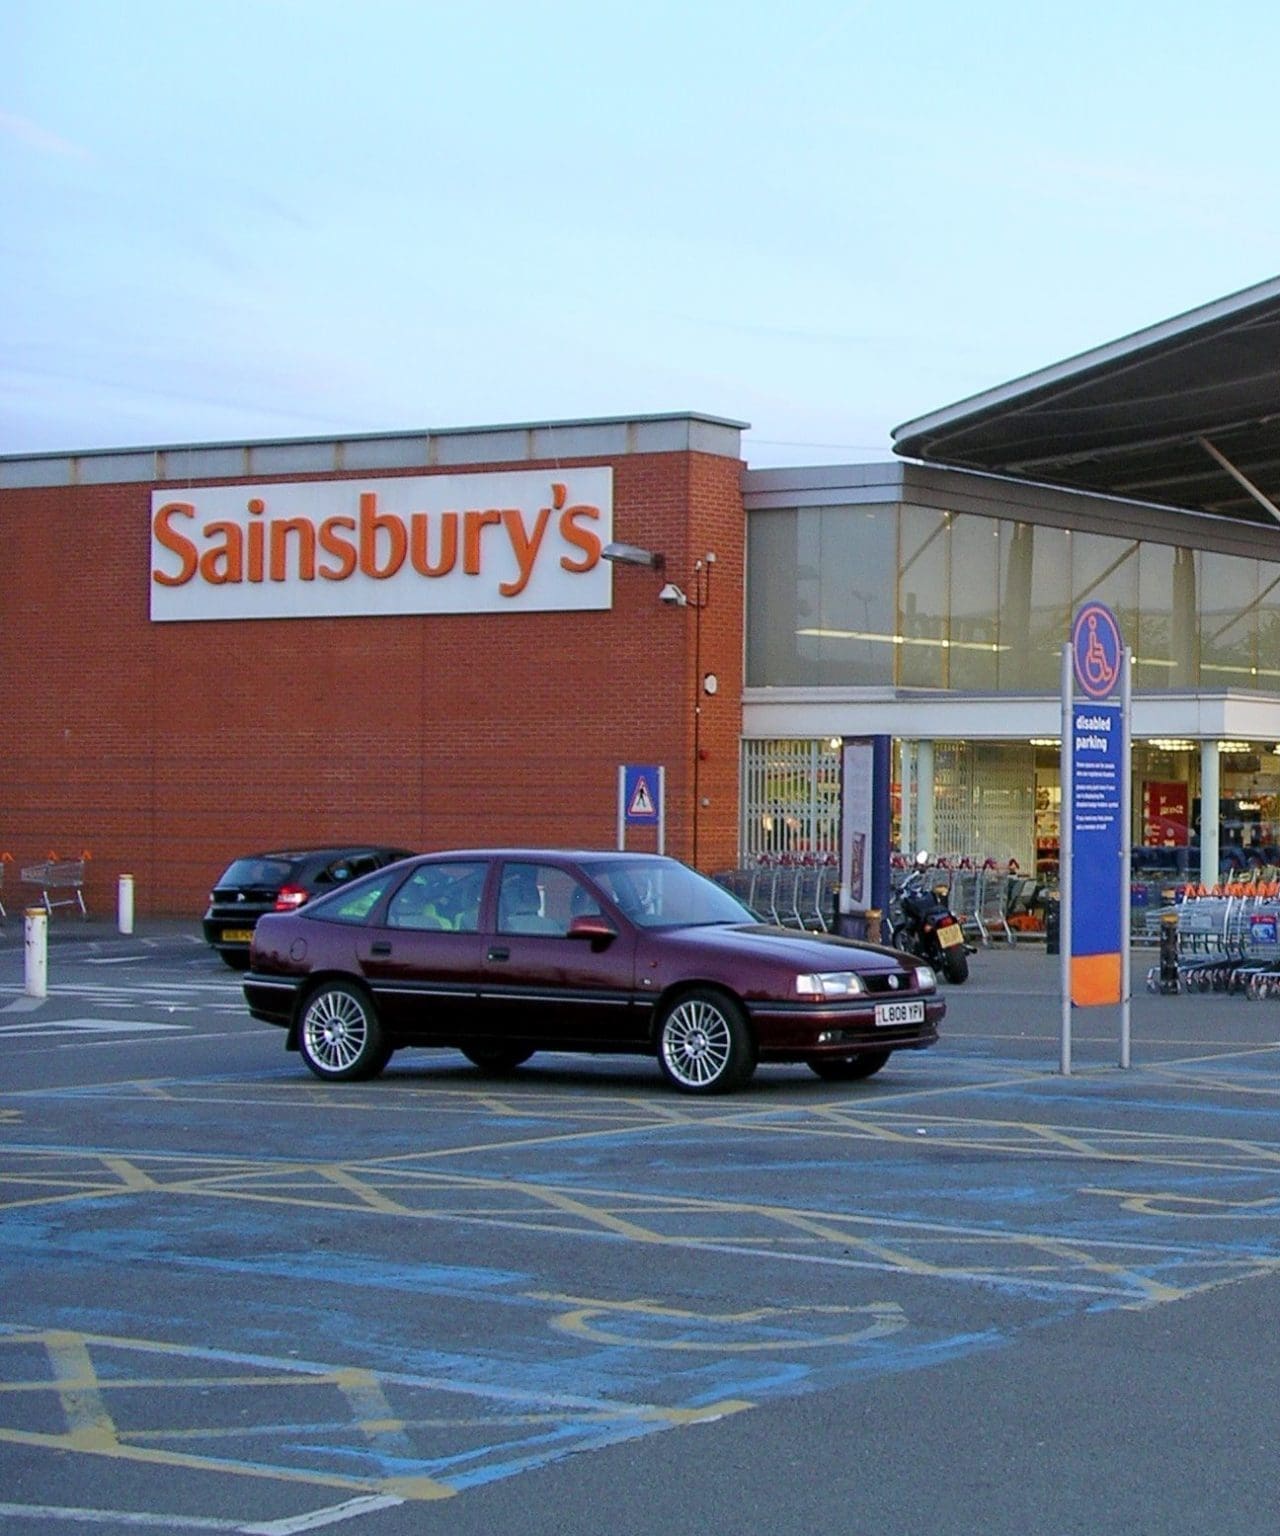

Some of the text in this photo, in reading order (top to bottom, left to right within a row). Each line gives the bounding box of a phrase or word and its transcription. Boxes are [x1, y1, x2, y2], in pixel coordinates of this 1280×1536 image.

[153, 483, 601, 597] Sainsbury's
[1075, 715, 1111, 731] disabled
[1075, 735, 1107, 753] parking
